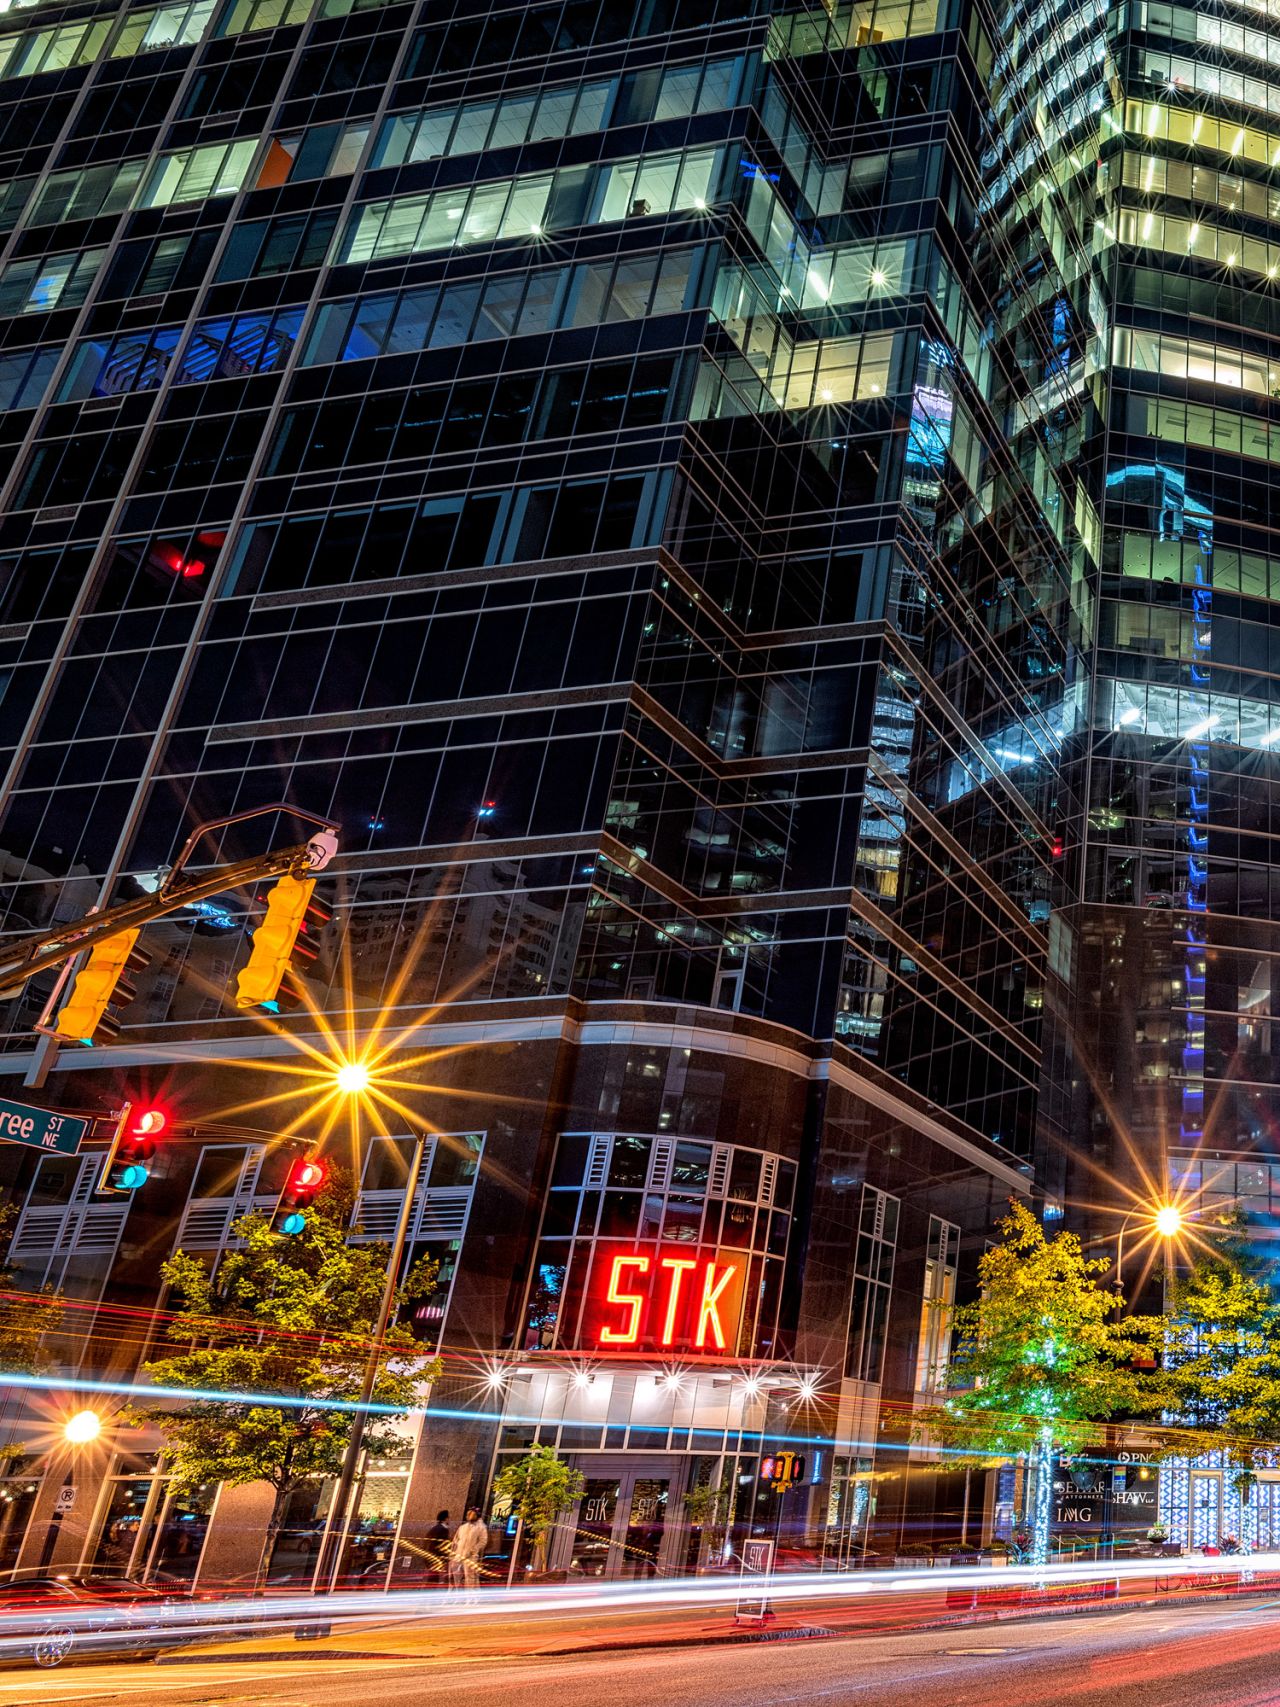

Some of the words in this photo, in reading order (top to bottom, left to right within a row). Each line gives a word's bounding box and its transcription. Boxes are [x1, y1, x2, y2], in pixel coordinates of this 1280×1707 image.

[48, 1116, 65, 1132] ST
[41, 1131, 60, 1148] NE
[600, 1256, 737, 1348] STK
[585, 1498, 609, 1521] STK
[1057, 1507, 1092, 1522] IMG
[749, 1546, 764, 1571] STK
